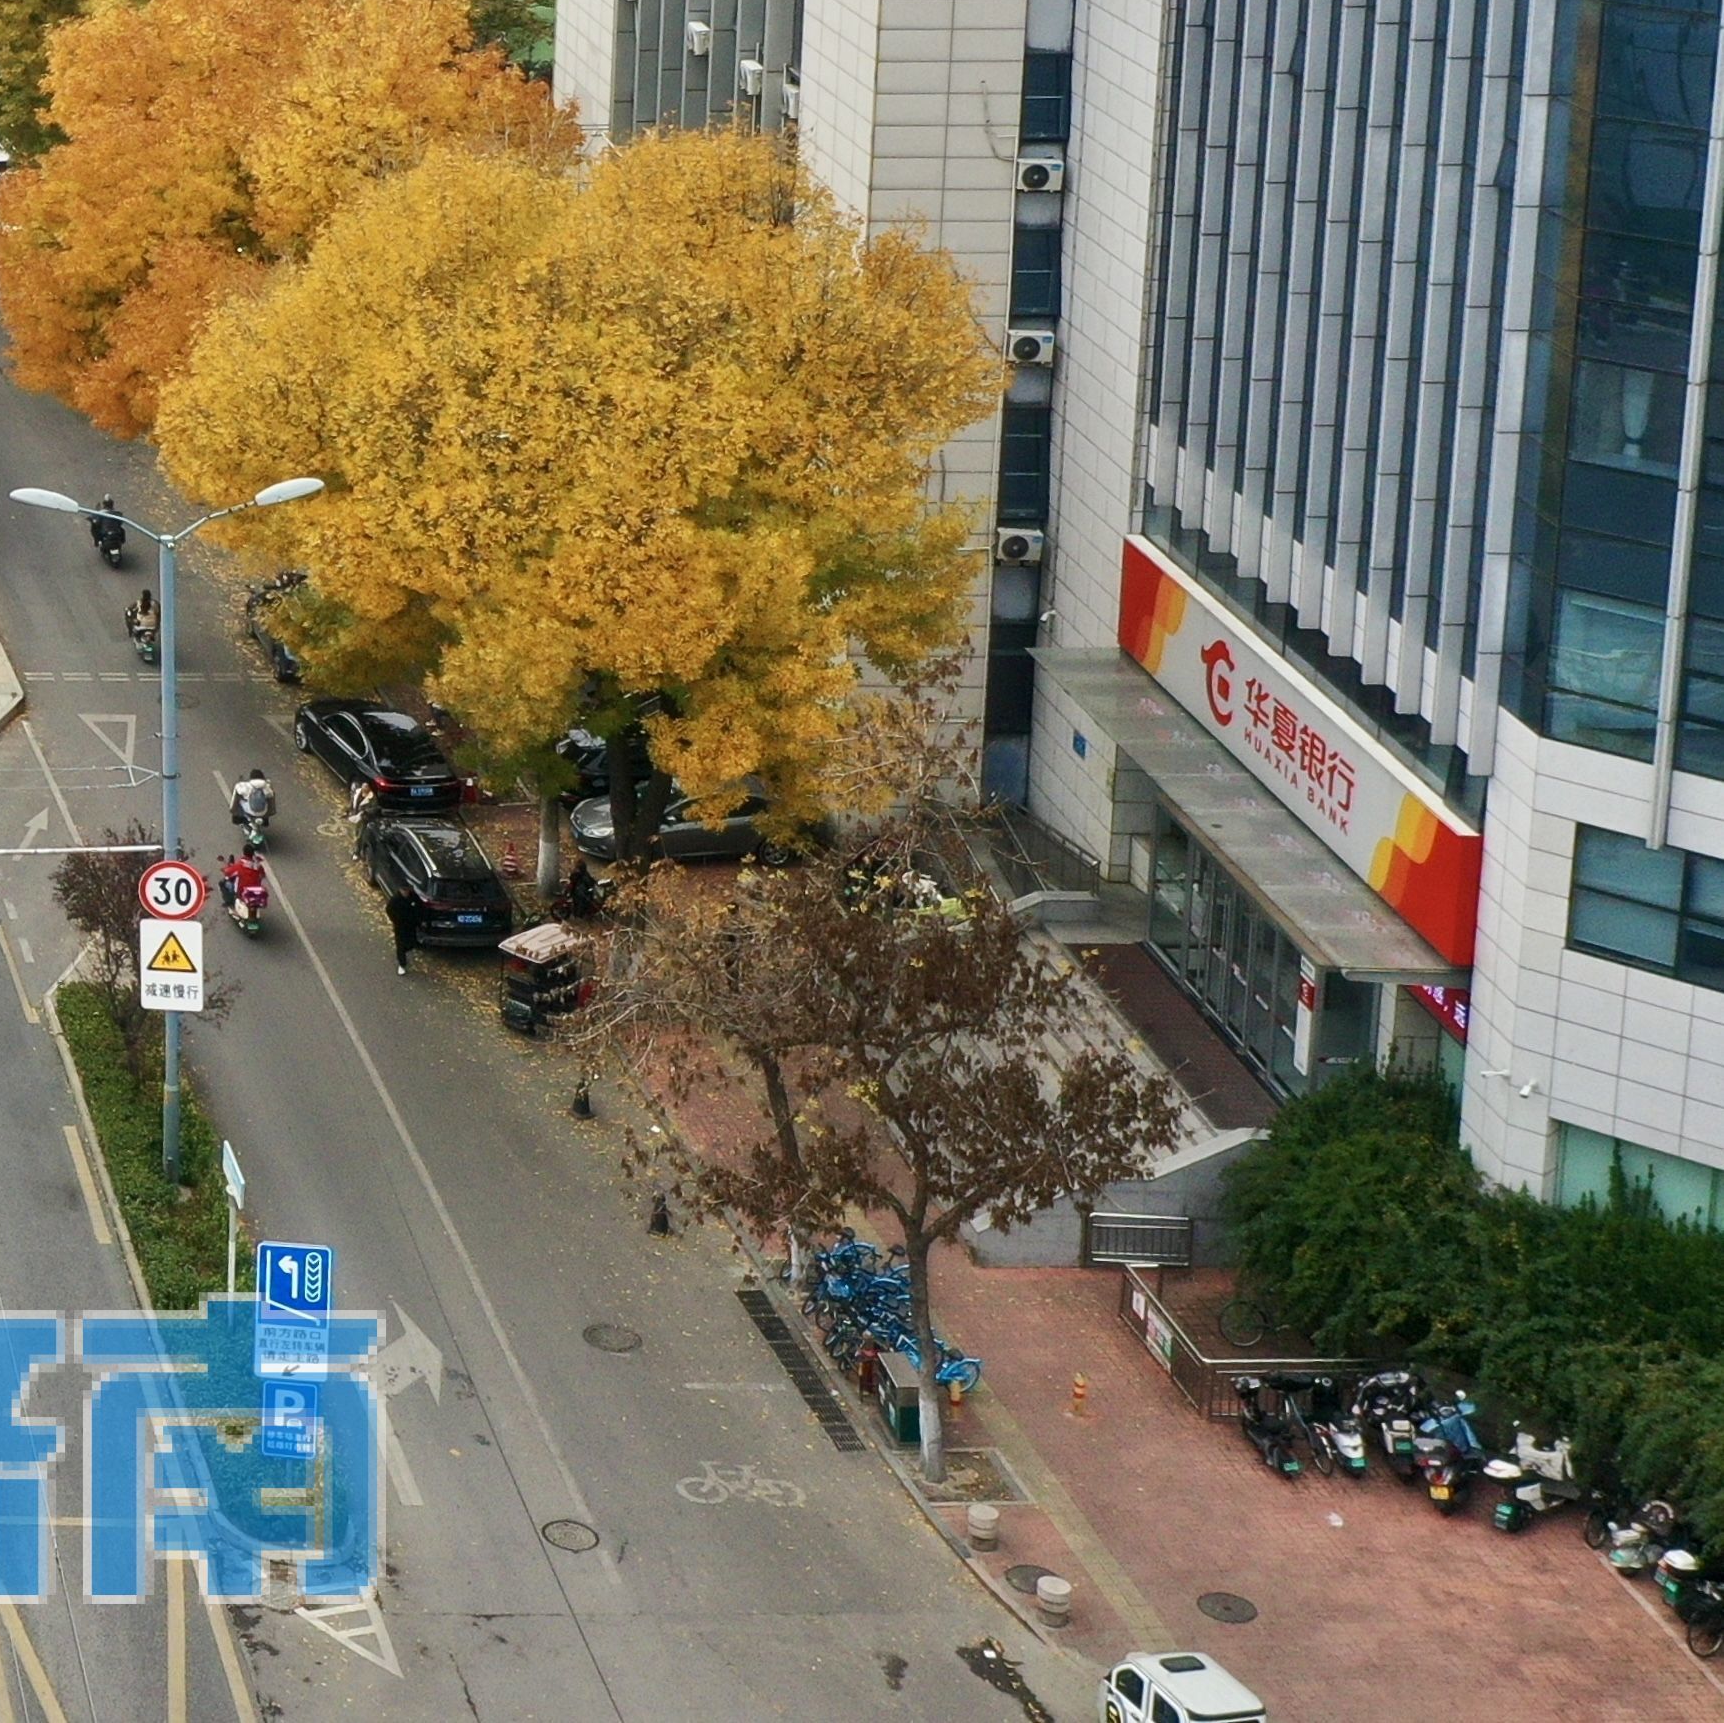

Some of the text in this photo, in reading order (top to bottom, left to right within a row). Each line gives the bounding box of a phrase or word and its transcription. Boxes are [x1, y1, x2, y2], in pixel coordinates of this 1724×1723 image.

[1244, 677, 1355, 812] 华夏银行
[1244, 726, 1349, 837] HUAXIA BANK
[153, 877, 192, 906] 30
[145, 982, 199, 1000] 减速慢行
[274, 1388, 305, 1427] P
